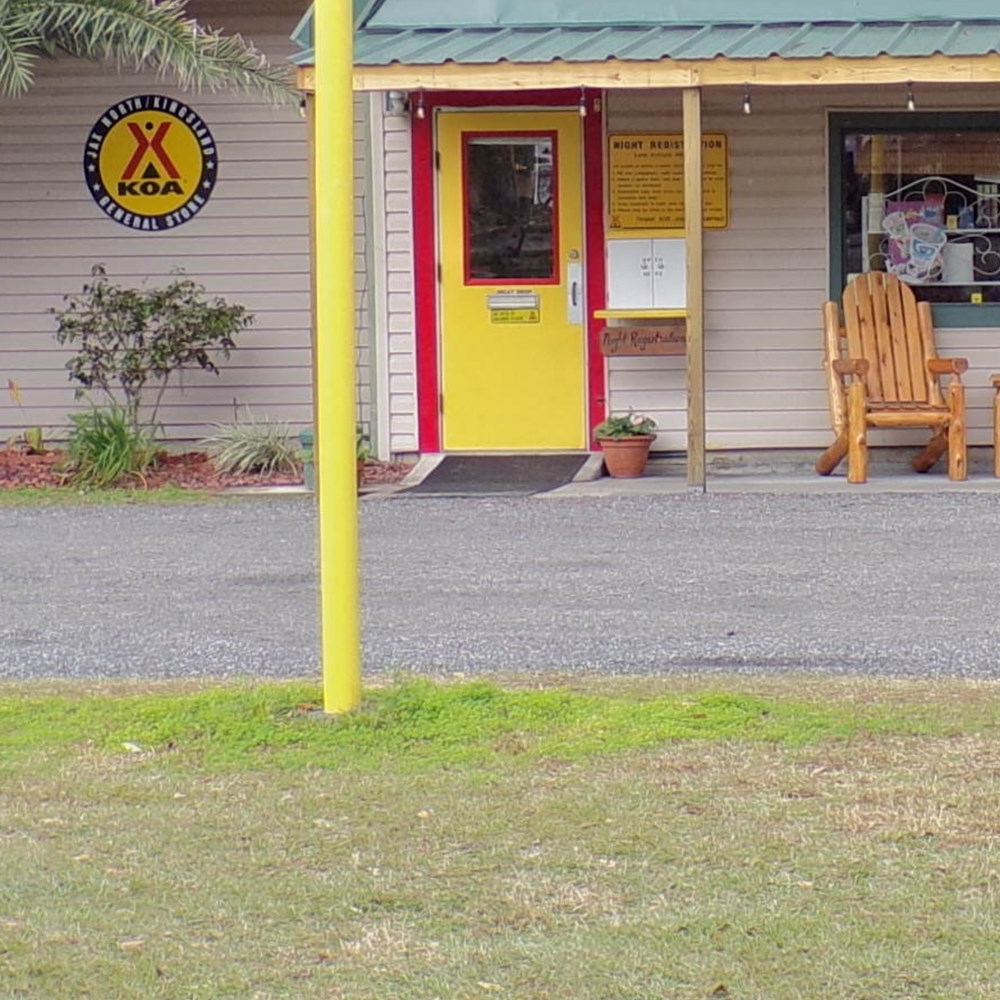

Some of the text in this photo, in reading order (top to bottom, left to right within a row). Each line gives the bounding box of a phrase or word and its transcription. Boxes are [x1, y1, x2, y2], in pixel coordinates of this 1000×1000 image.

[86, 132, 103, 158] JAX
[613, 141, 643, 150] NIGHT
[118, 181, 185, 196] KOA
[100, 195, 205, 230] GENERAL STORE
[603, 331, 627, 353] Night
